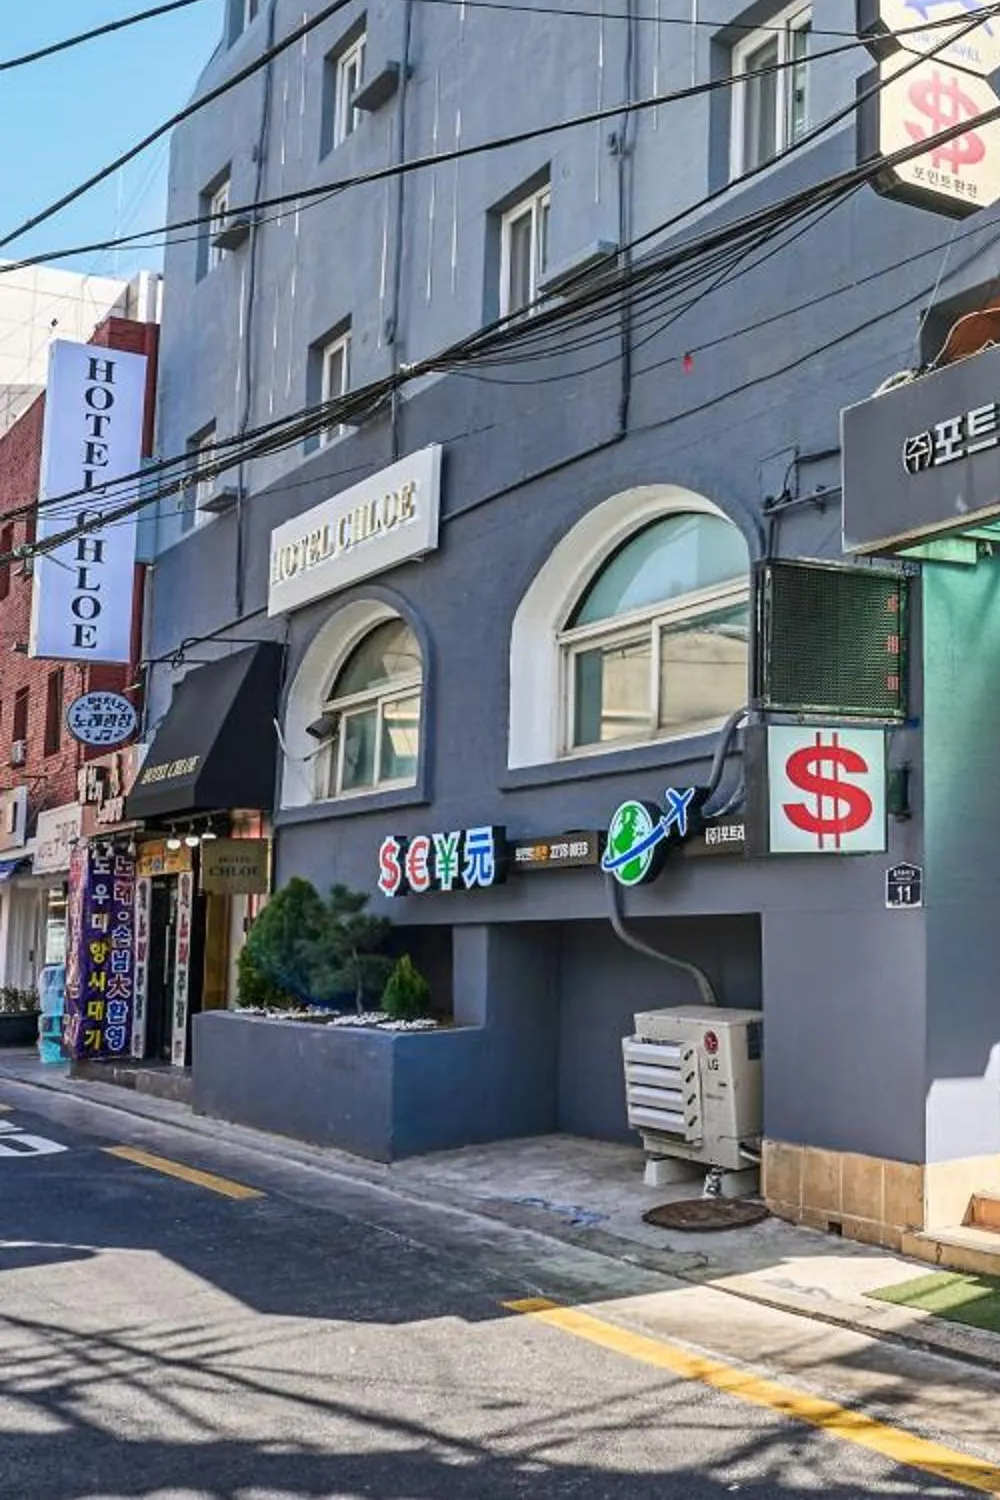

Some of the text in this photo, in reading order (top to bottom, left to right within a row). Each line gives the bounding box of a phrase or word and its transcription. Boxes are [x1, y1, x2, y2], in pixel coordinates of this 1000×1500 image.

[71, 357, 116, 649] HOTEL CHLOE
[271, 480, 417, 586] HOTEL CHLOE
[783, 731, 874, 850] $
[208, 865, 260, 878] CHLOE
[897, 885, 911, 901] 11
[707, 1058, 720, 1072] LG
